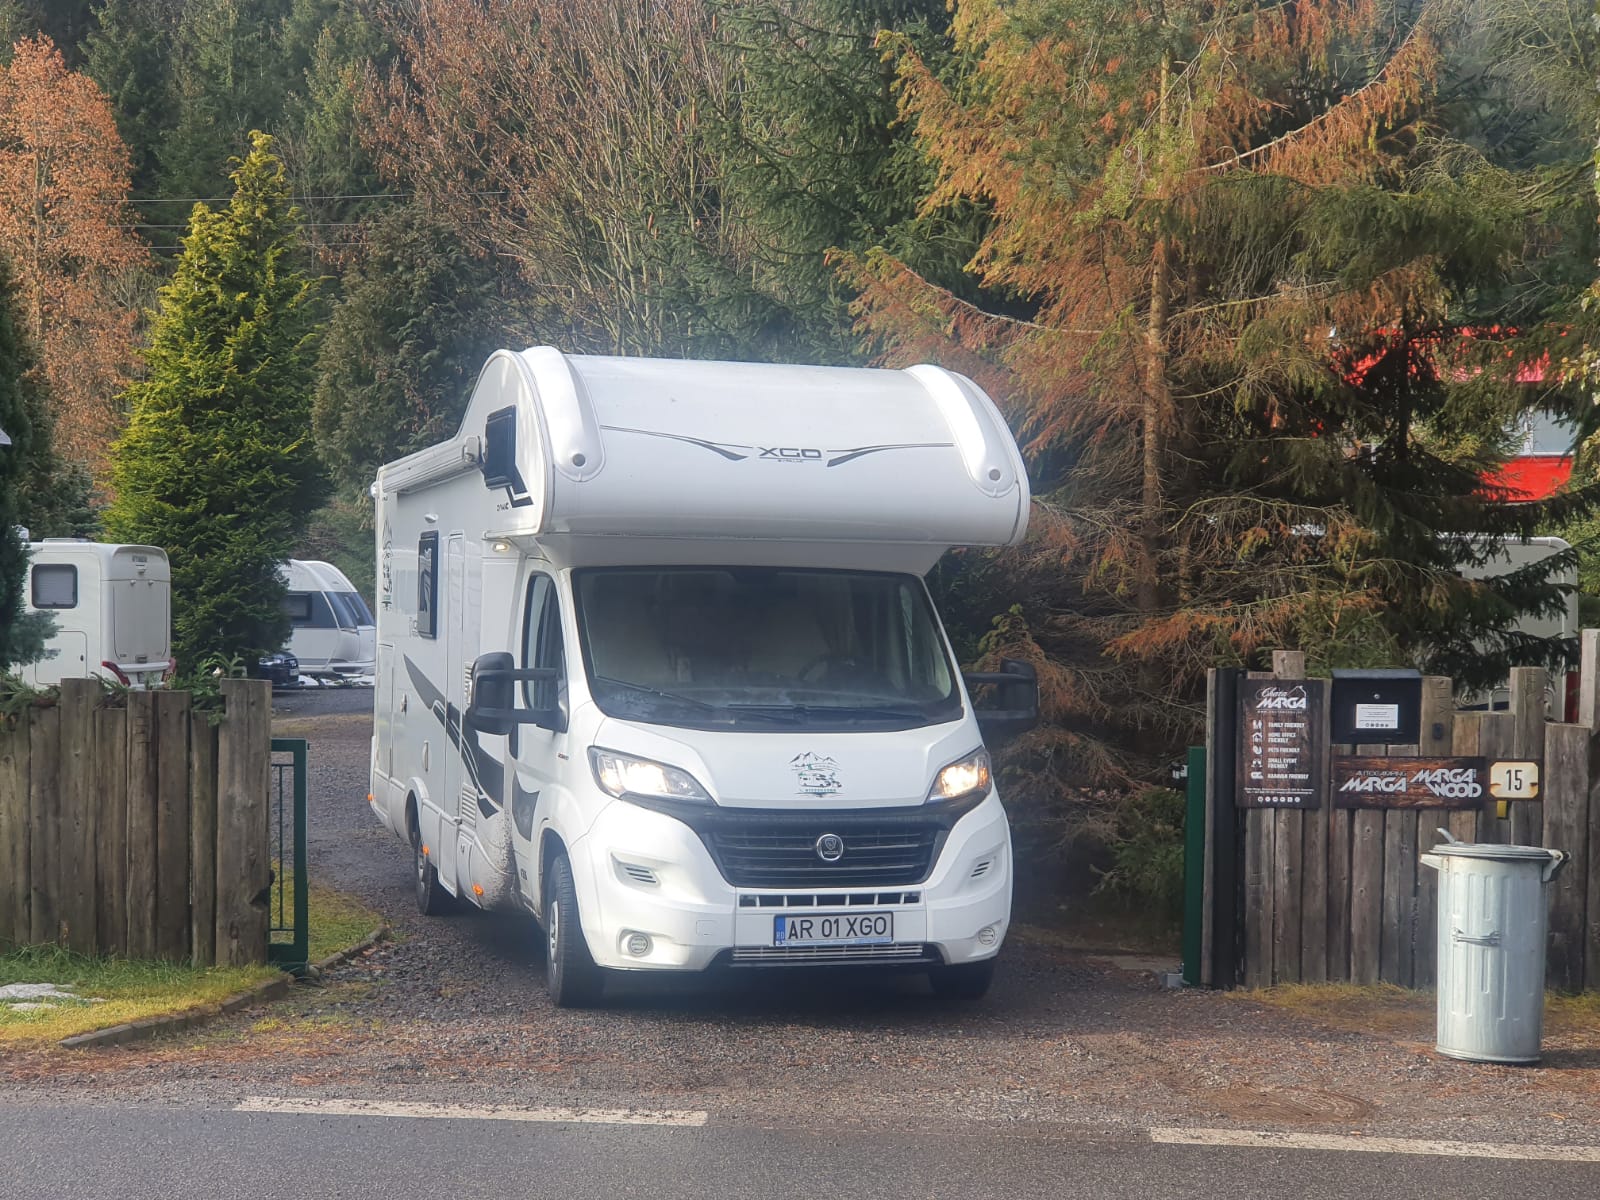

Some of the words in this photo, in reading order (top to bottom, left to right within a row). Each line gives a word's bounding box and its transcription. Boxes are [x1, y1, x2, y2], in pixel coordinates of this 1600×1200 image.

[757, 447, 822, 458] XGO
[1256, 697, 1306, 709] MARGA
[1410, 768, 1473, 783] MARGA
[1505, 769, 1523, 792] 15
[1339, 777, 1407, 793] MARGA
[1427, 782, 1482, 798] WOOD
[788, 919, 813, 940] AR
[821, 918, 839, 938] 01
[846, 917, 887, 938] XGO
